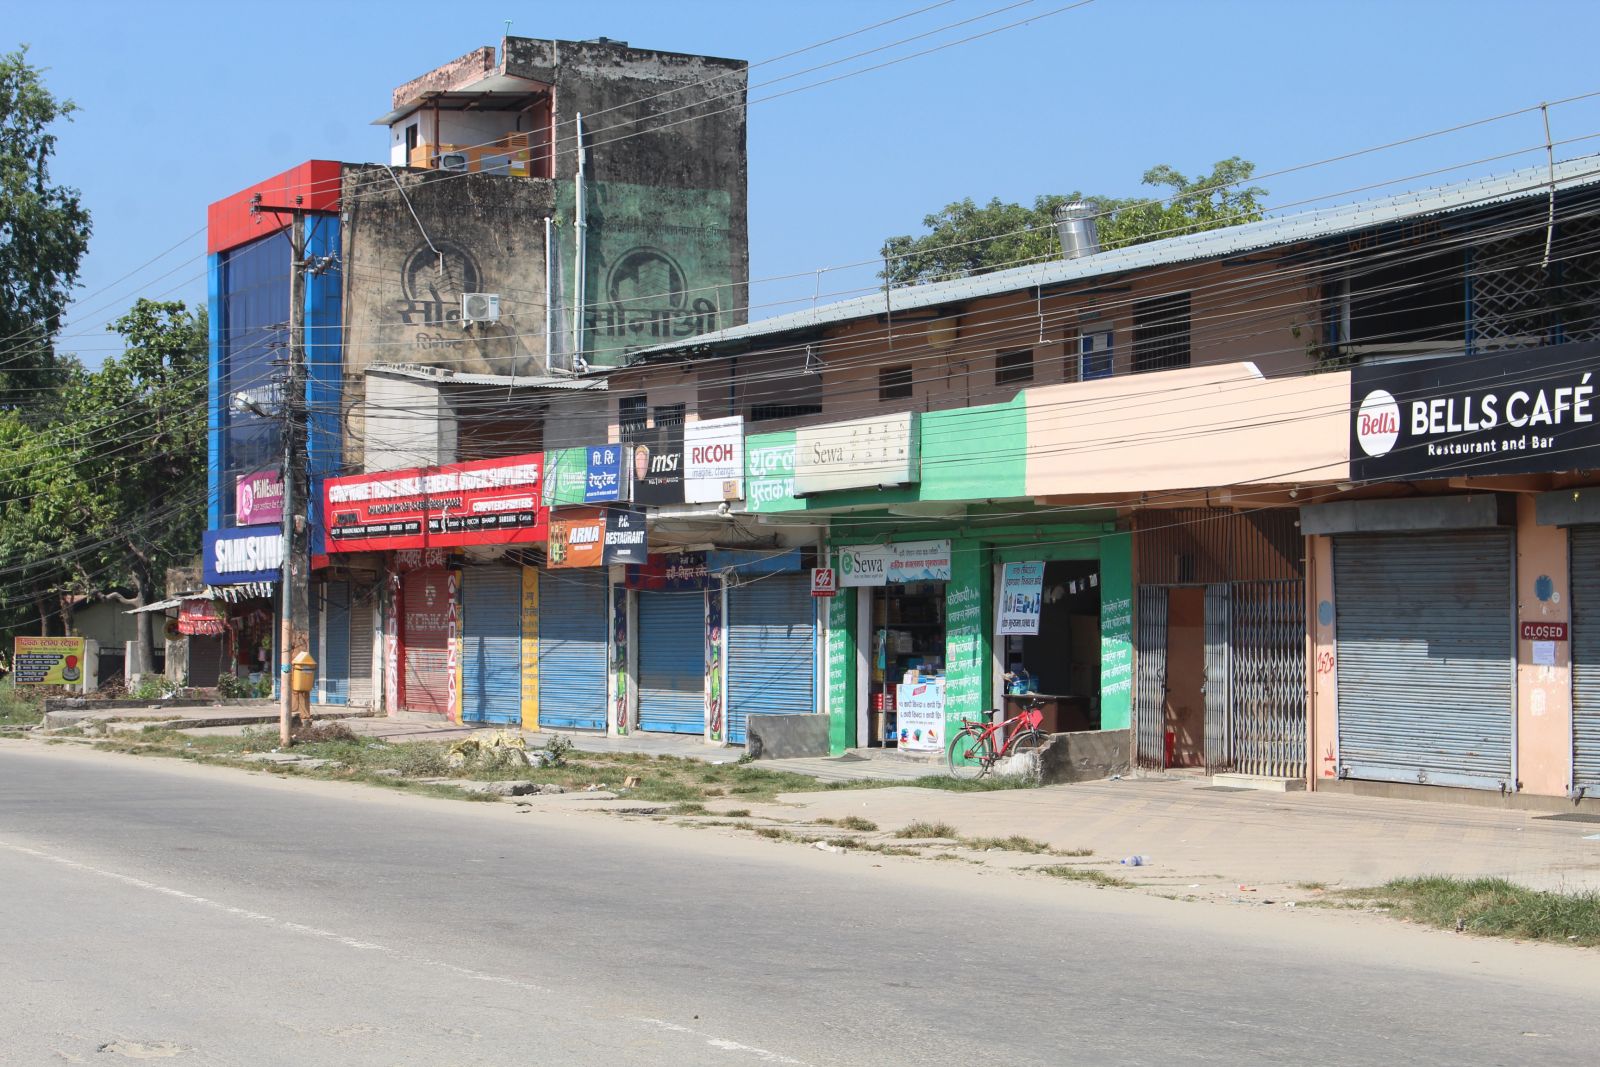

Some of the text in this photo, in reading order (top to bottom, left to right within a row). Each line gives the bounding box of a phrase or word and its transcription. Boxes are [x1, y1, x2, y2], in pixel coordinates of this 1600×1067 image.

[1411, 372, 1594, 436] BELLS CAFÉ
[692, 444, 733, 464] RICOH
[1428, 435, 1555, 456] Restaurant and Bar
[651, 454, 679, 473] msi
[569, 526, 600, 544] ARNA
[605, 531, 645, 546] RESTAURANT
[842, 552, 884, 575] eSewa
[1524, 626, 1563, 638] CLOSED
[448, 599, 456, 711] KONKA
